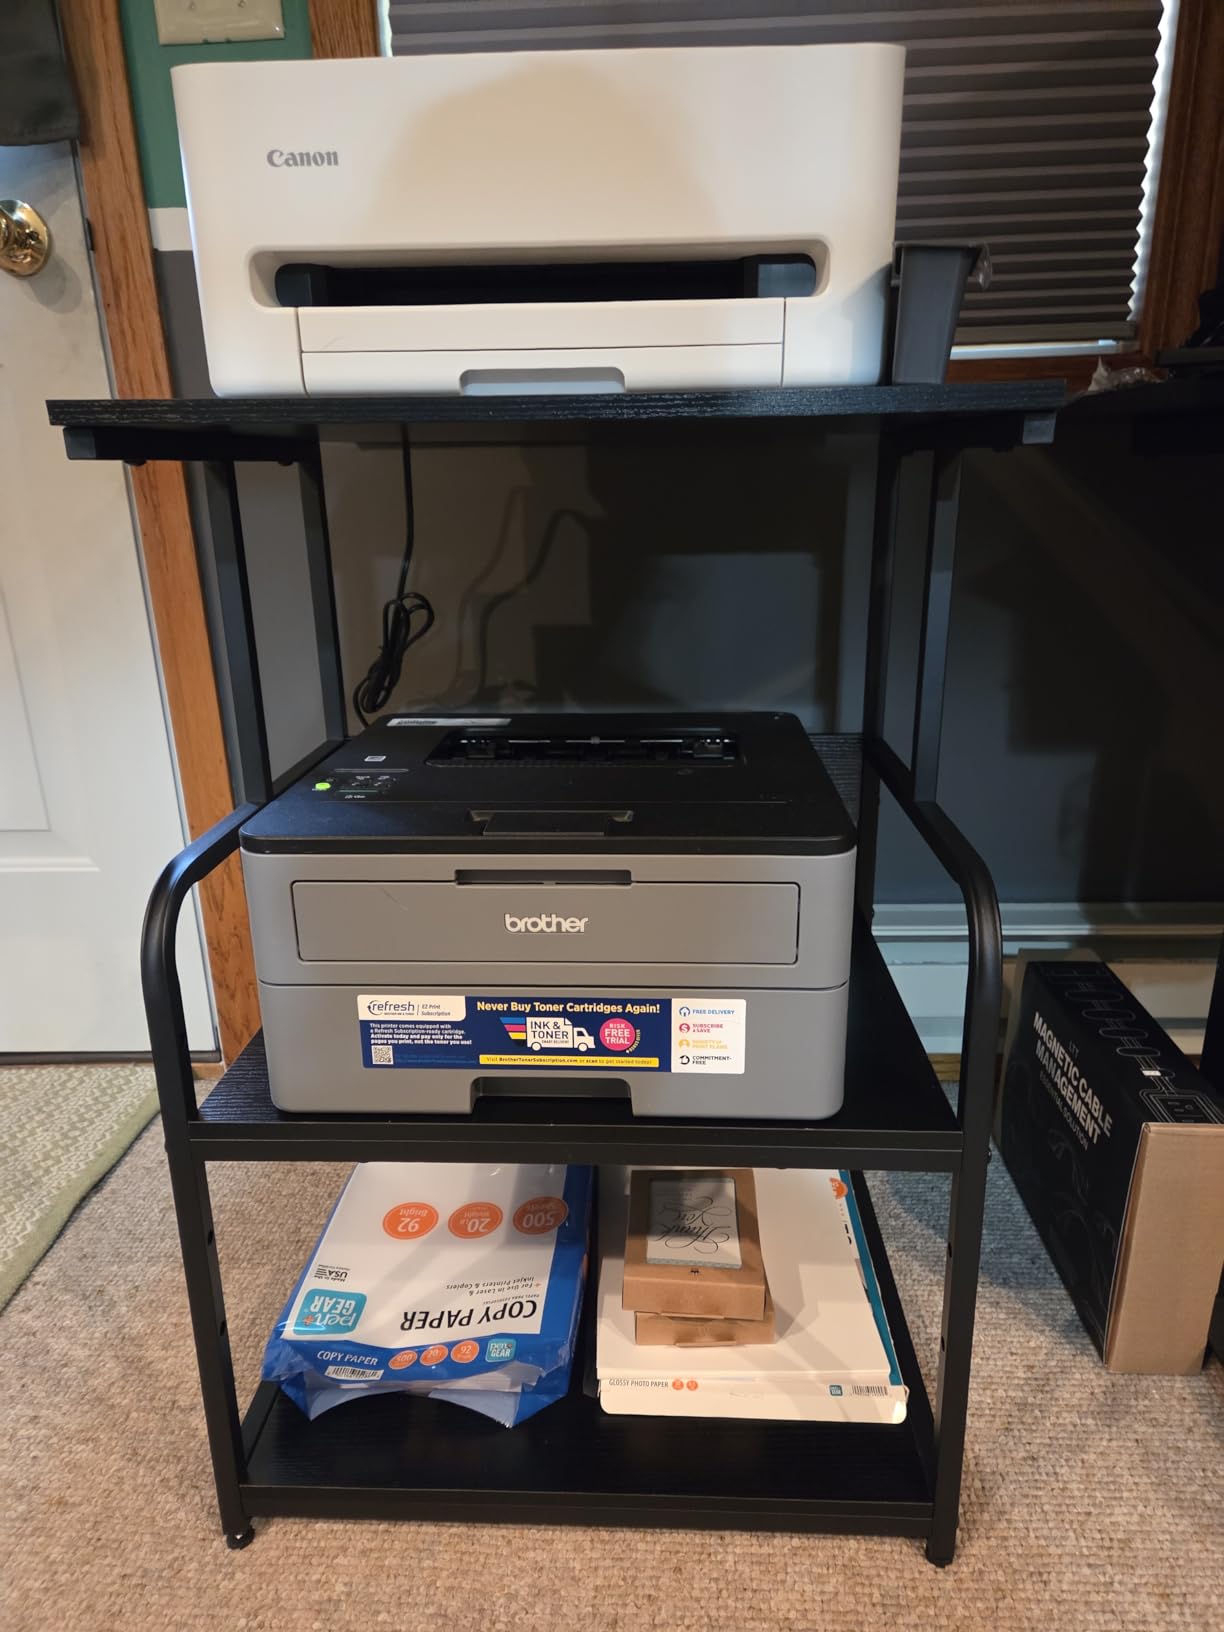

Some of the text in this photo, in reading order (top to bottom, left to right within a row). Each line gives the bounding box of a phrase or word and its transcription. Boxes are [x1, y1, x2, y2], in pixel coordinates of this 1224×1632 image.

[267, 149, 339, 168] Canon
[504, 913, 589, 933] brother
[372, 1001, 415, 1012] refresh
[477, 1001, 660, 1014] Never Buy Toner Cartridges Again!
[530, 1021, 561, 1030] INK &
[531, 1030, 569, 1040] TONER
[604, 1028, 631, 1037] FREE
[1034, 1012, 1113, 1138] MAGNETIC CABLE
[1036, 1039, 1101, 1145] MANAGEMENT
[1062, 1106, 1089, 1151] SOLUTION
[400, 1208, 428, 1217] Bright
[397, 1217, 421, 1233] 92
[522, 1211, 555, 1228] 500
[653, 1223, 732, 1254] Thank
[328, 1270, 348, 1279] USA
[512, 1276, 535, 1284] Inkjet
[477, 1287, 496, 1295] Laser
[310, 1295, 356, 1315] GEAR
[400, 1300, 538, 1332] COPY PAPER
[461, 1346, 472, 1354] 92
[491, 1349, 511, 1358] GEAR
[317, 1350, 379, 1366] COPY PAPER
[609, 1378, 629, 1386] GLOSSY
